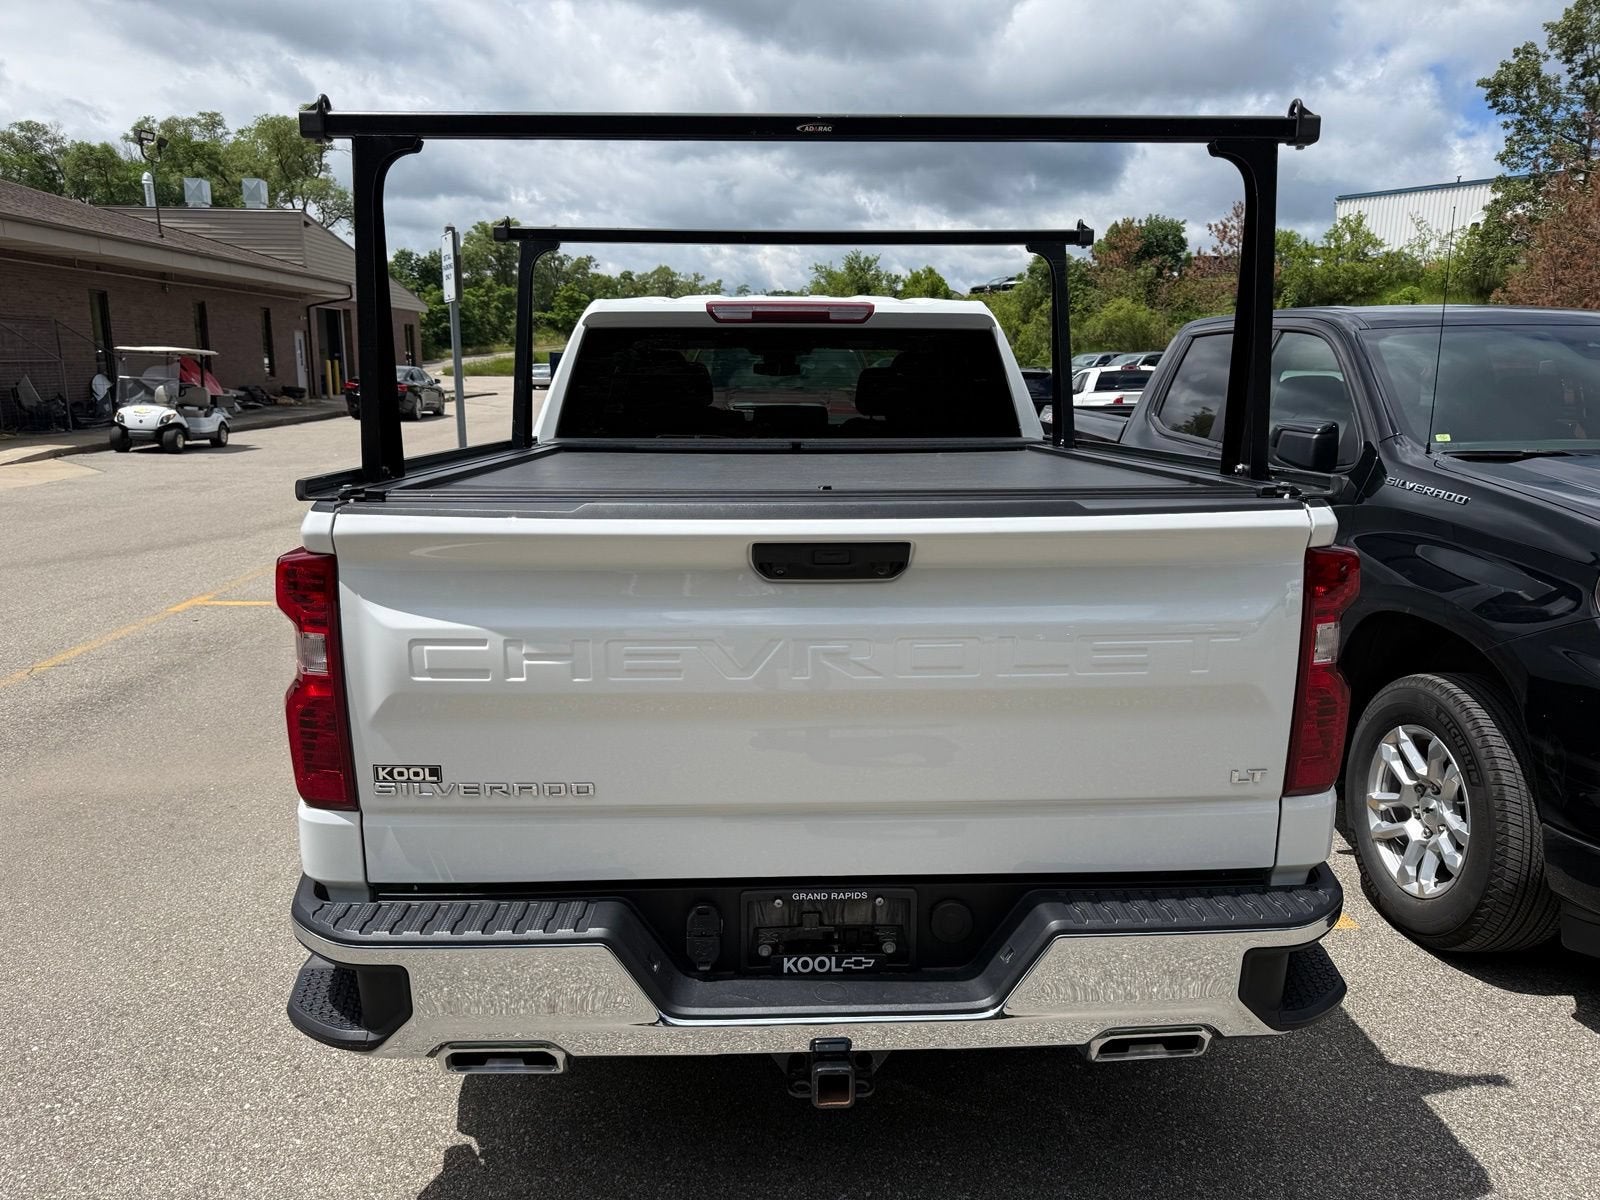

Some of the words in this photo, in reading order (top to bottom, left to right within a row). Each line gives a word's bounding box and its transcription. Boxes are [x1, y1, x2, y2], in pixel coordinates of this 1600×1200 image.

[1385, 476, 1468, 505] SILVERADO
[408, 632, 1241, 682] CHEVROLET
[377, 767, 438, 781] KOOL
[1230, 768, 1268, 784] LT
[373, 782, 595, 797] SILVERADO
[792, 892, 828, 901] GRAND
[831, 891, 868, 900] RAPIDS
[783, 956, 843, 973] KOOL
